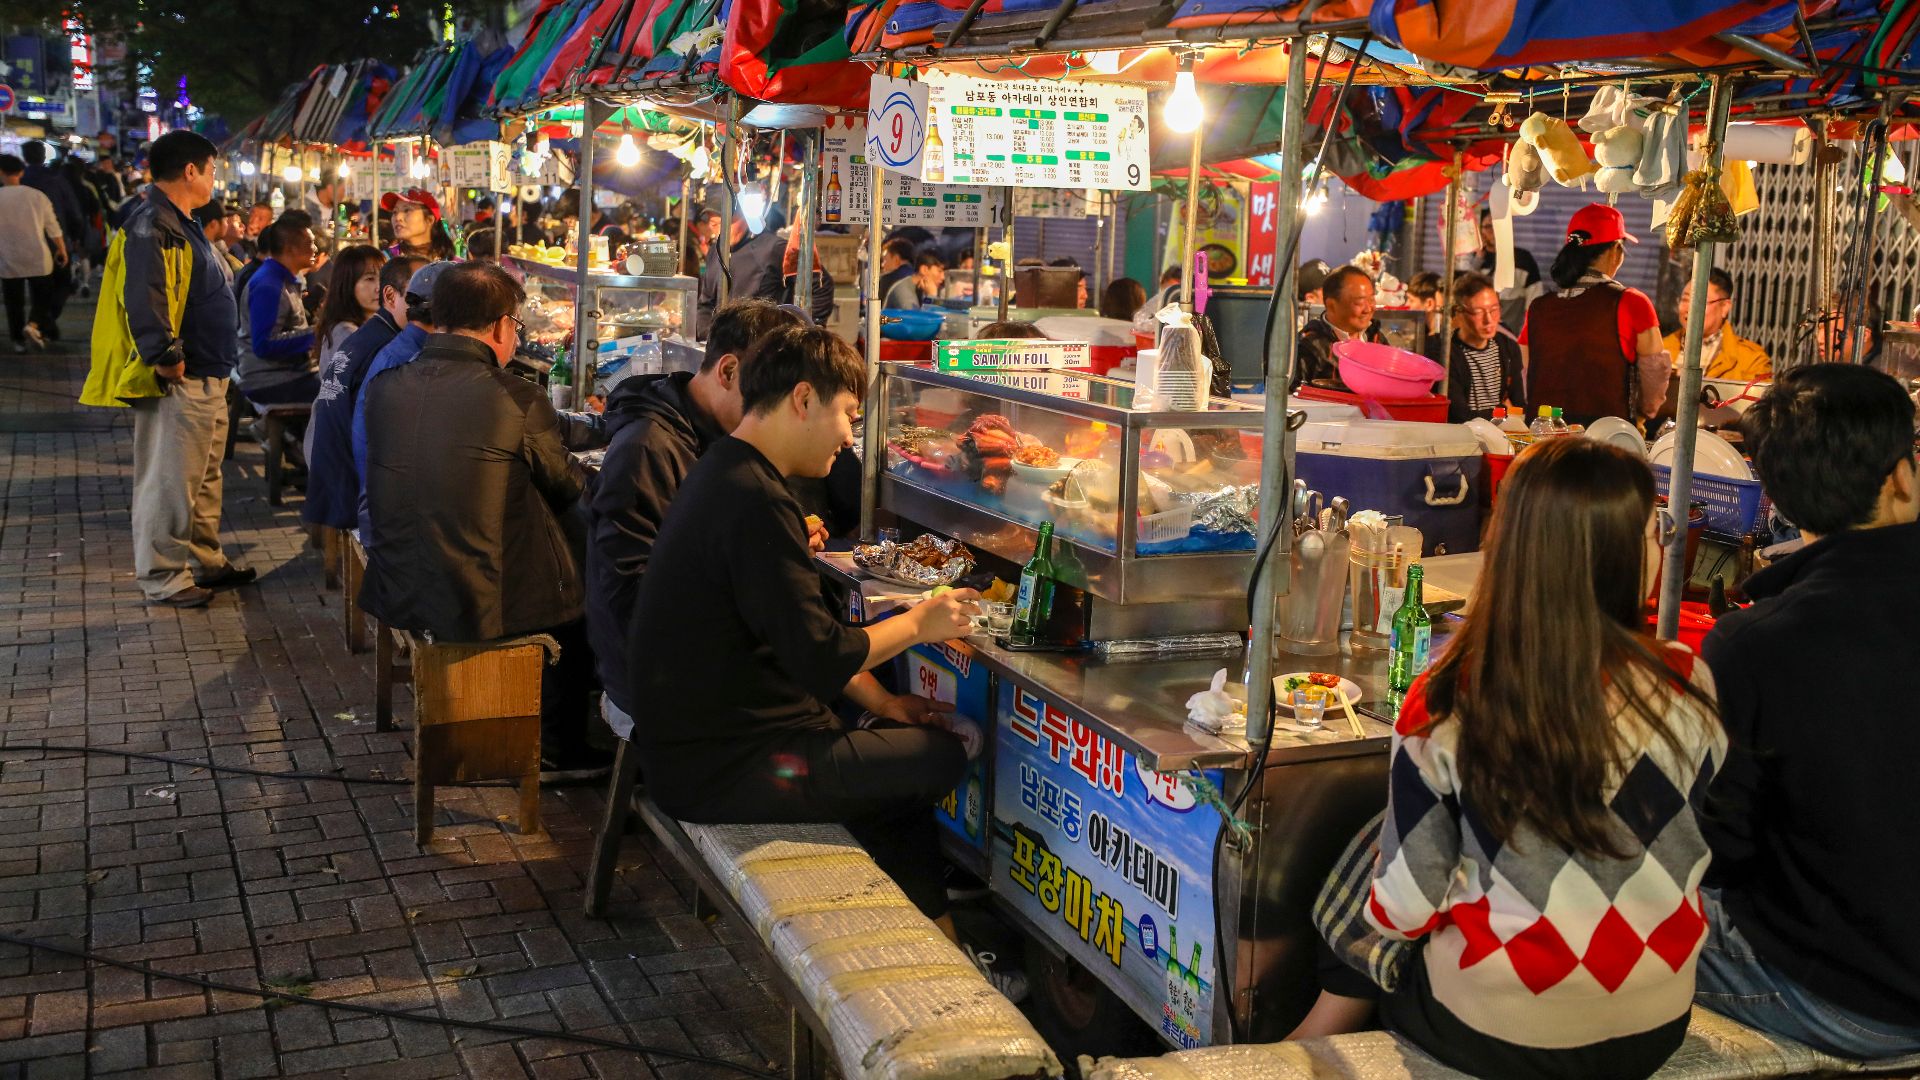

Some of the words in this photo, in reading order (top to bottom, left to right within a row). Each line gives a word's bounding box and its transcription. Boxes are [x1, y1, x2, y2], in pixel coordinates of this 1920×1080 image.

[966, 90, 997, 103] 남포동
[1001, 93, 1042, 105] 아카데미
[1048, 95, 1098, 109] 상인연합회
[890, 112, 904, 154] 9
[1127, 163, 1140, 187] 9
[1074, 207, 1086, 218] 29
[973, 353, 999, 366] SAM
[1001, 353, 1021, 366] JIN
[1024, 352, 1050, 365] FOIL
[1020, 762, 1083, 842] 남포동
[1088, 810, 1180, 920] 아카데미
[1010, 829, 1126, 968] 포장마차
